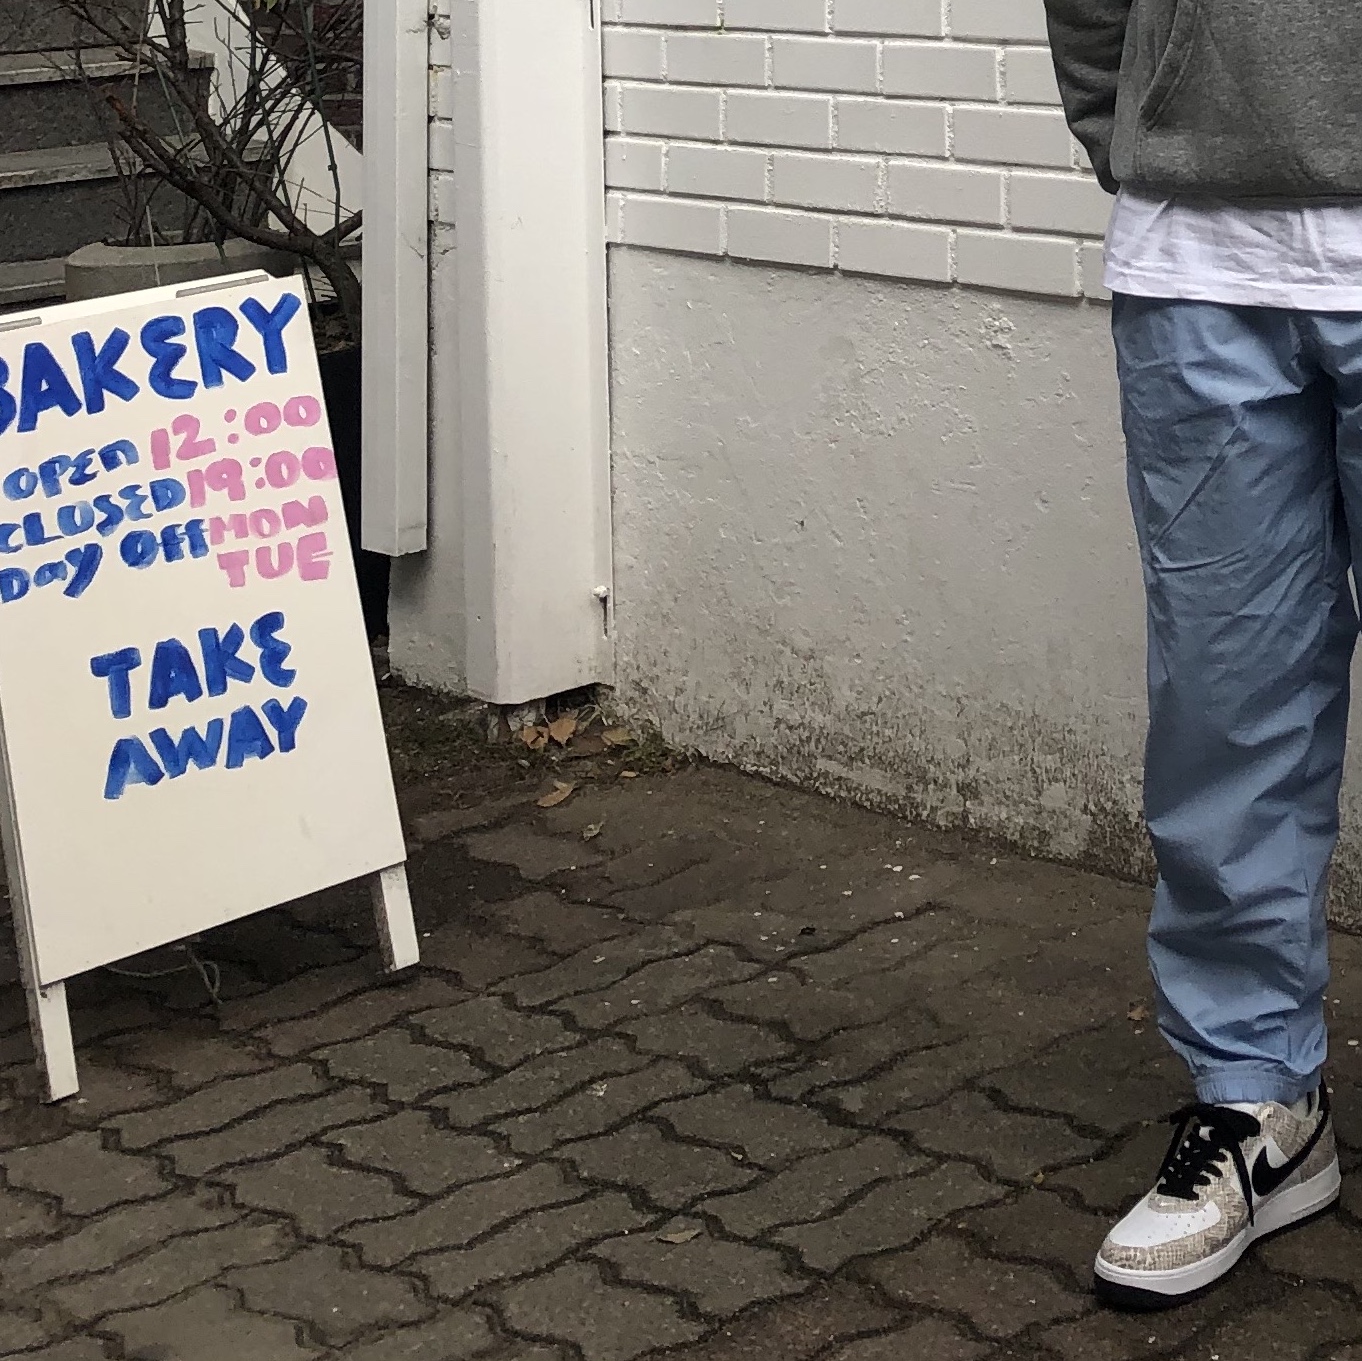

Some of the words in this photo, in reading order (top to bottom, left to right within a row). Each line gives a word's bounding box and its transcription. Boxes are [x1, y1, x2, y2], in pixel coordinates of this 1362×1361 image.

[150, 395, 322, 471] 12:00
[0, 477, 187, 554] CLOSED
[186, 446, 338, 509] 19:00
[208, 495, 329, 546] MON
[216, 531, 334, 588] TUE
[90, 611, 297, 720] TAKE
[103, 695, 308, 800] AWAY
